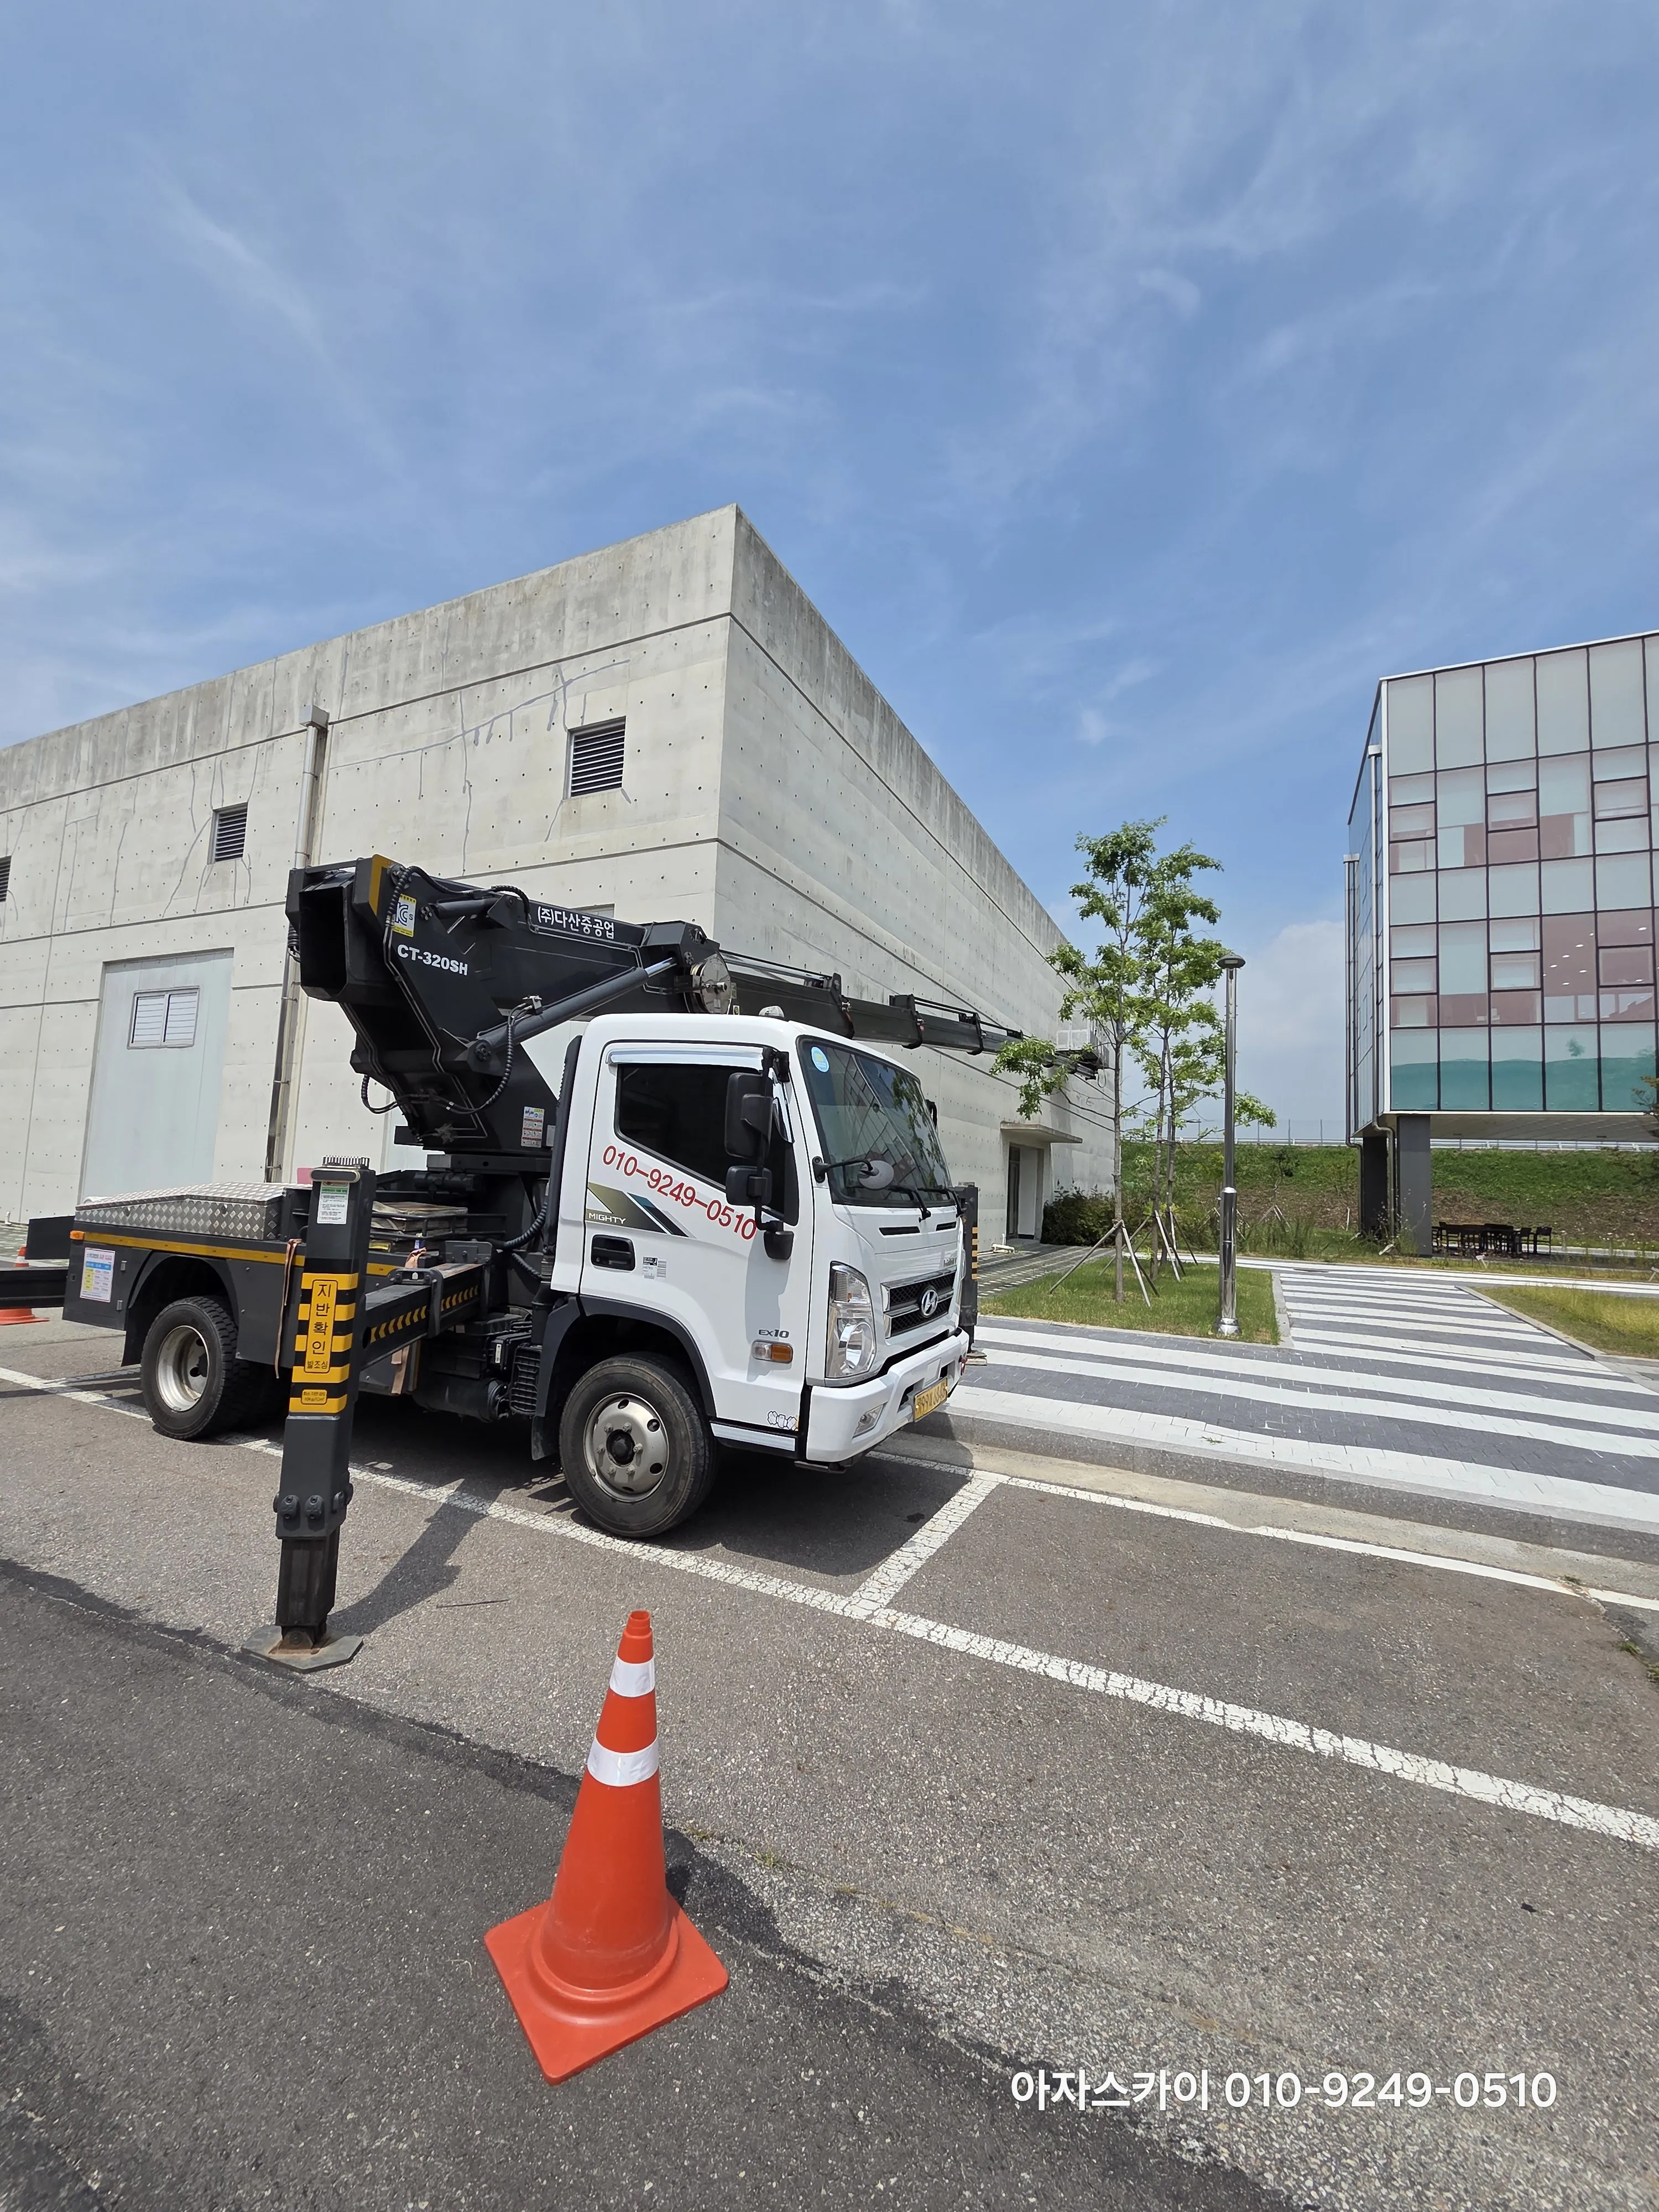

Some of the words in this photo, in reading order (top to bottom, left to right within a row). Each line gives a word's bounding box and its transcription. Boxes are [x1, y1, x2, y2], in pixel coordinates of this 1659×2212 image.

[538, 906, 614, 940] (주)다산중공업
[397, 944, 468, 975] CT-320SH
[603, 1145, 757, 1240] 010-9249-0510
[588, 1212, 627, 1224] MIGHTY
